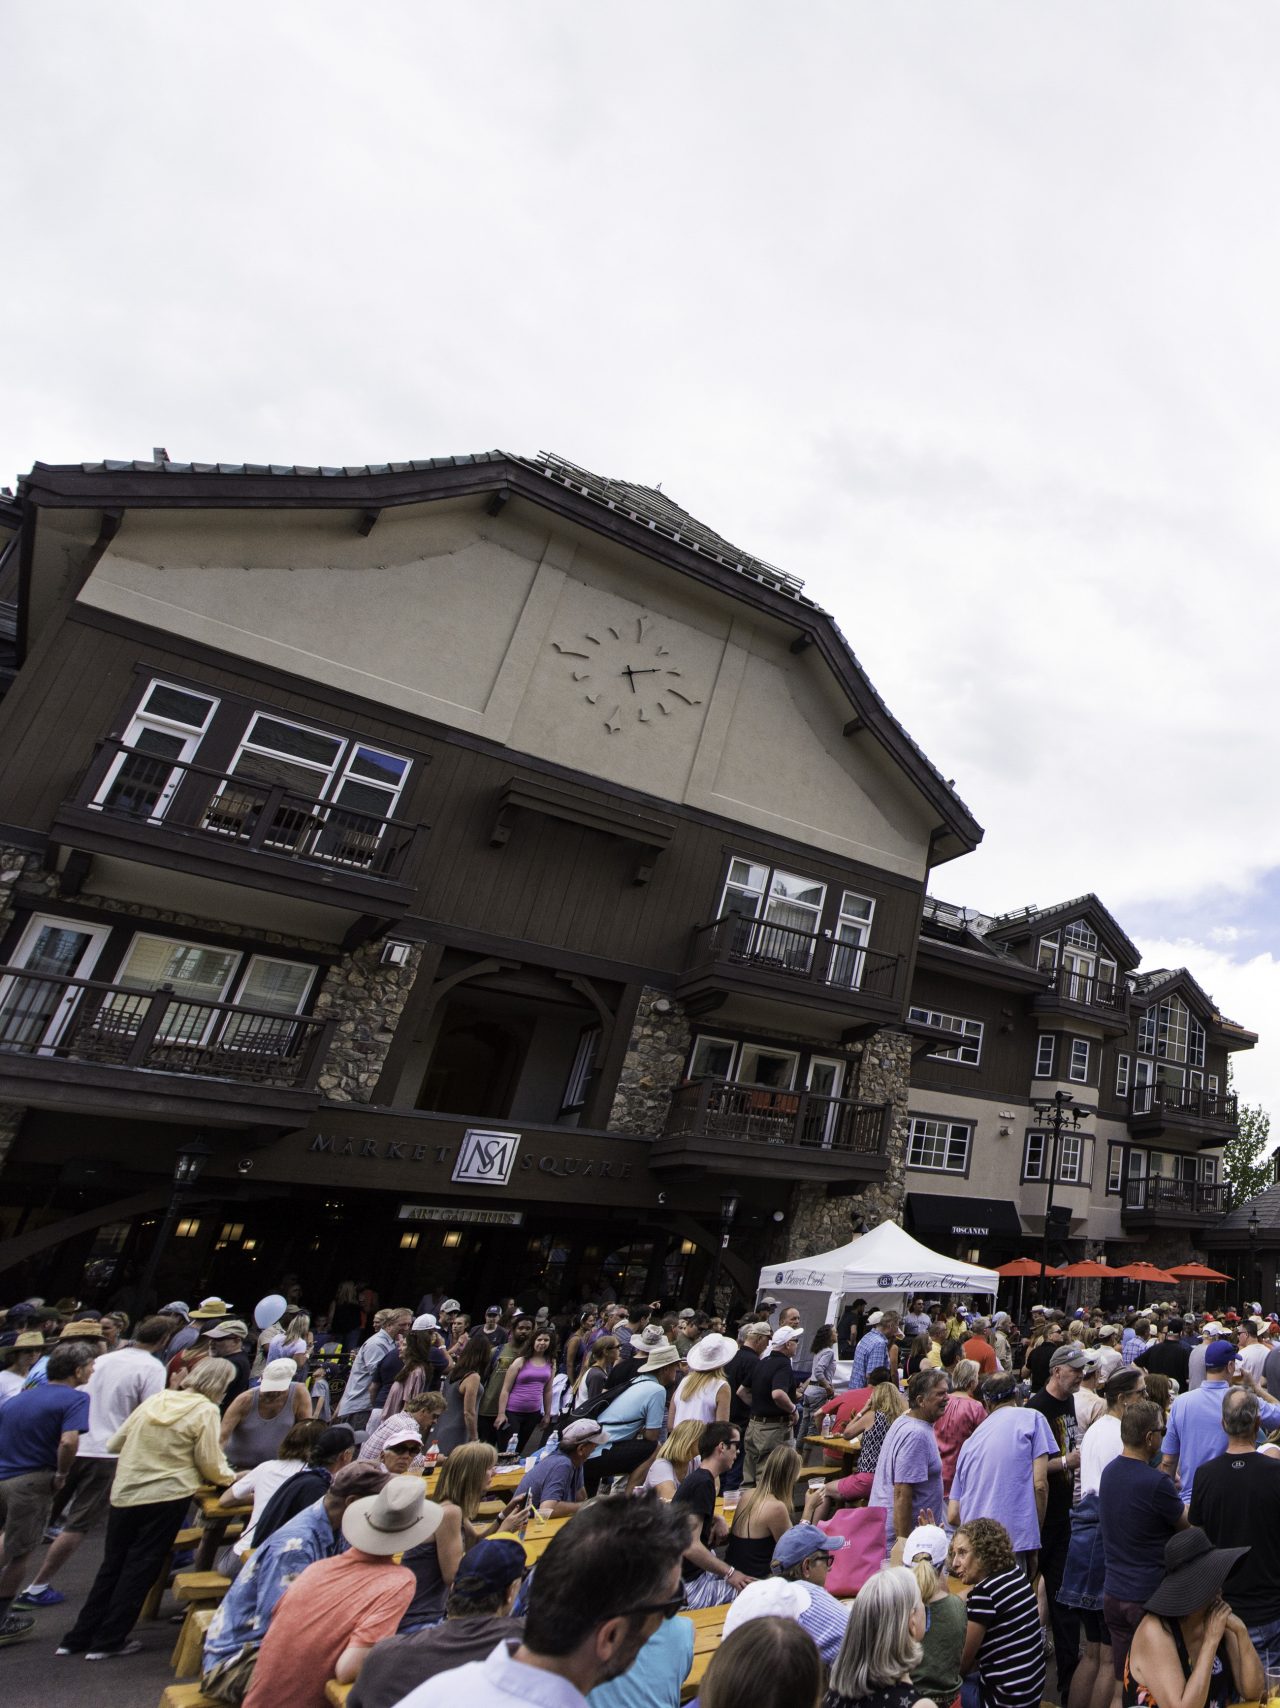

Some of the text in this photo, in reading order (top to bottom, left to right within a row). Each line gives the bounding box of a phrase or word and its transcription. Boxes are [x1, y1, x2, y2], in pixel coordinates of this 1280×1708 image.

[310, 1133, 451, 1163] MARKET
[520, 1153, 632, 1178] SQUARE
[408, 1207, 515, 1224] ART GALLERIES
[952, 1226, 989, 1235] TOSCANINI
[784, 1271, 825, 1287] Beaver Creek
[895, 1273, 938, 1289] Beaver
[940, 1274, 969, 1289] Creek
